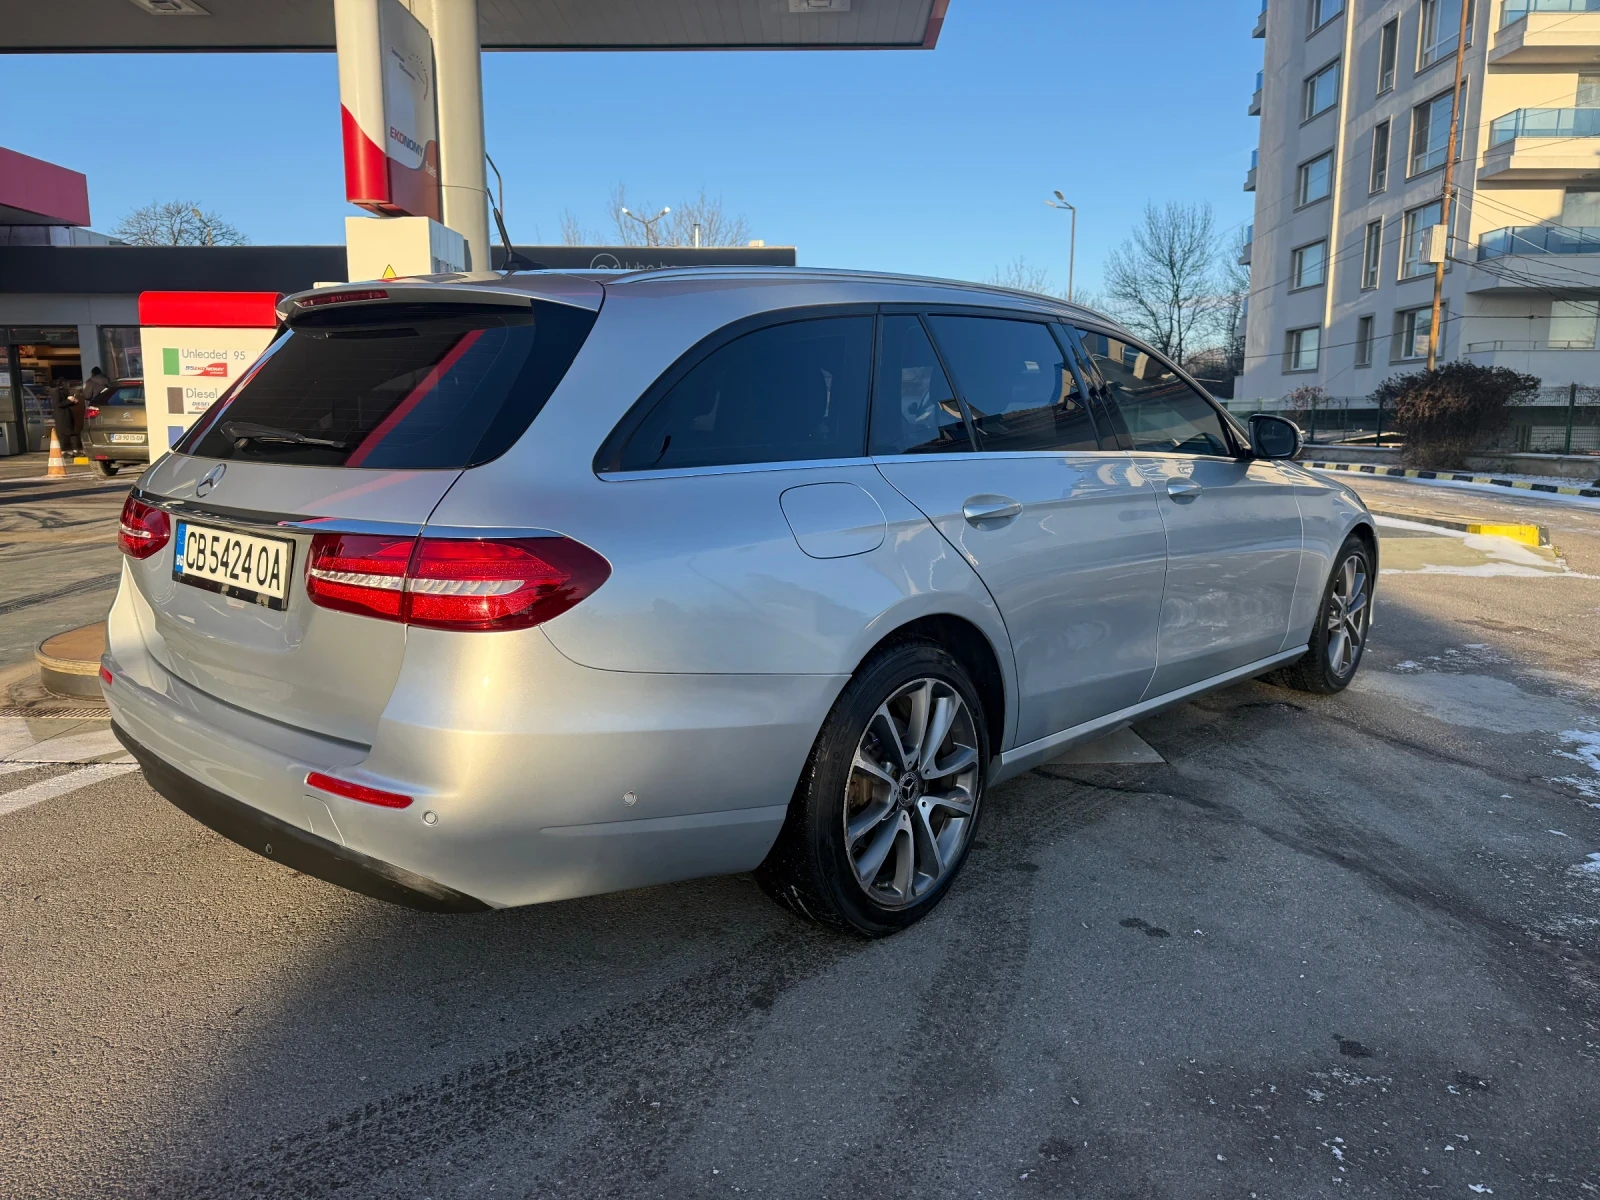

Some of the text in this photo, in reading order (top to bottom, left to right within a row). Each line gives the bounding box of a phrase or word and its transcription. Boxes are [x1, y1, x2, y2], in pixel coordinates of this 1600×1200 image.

[390, 125, 424, 157] EKONOMY
[181, 348, 246, 360] Unleaded 95
[185, 387, 218, 399] Diesel
